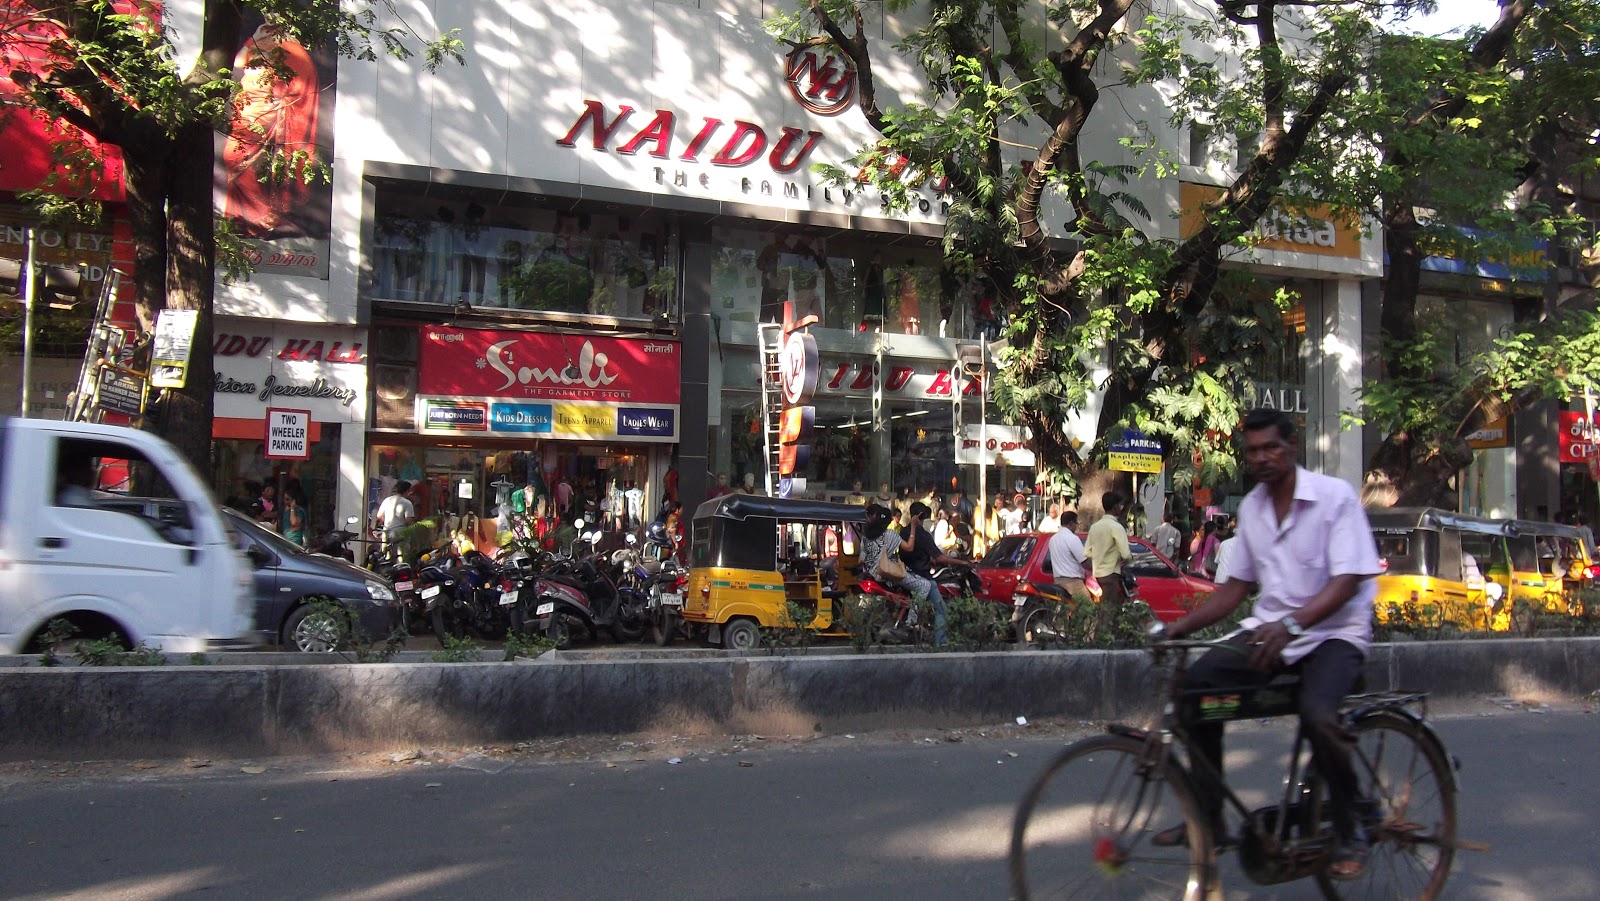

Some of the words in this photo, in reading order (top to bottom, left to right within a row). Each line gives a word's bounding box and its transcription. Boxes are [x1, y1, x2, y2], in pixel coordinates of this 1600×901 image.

[786, 52, 857, 99] NH
[556, 100, 827, 174] NAIDU
[653, 166, 709, 190] THE
[741, 177, 854, 206] FAMILY
[277, 339, 368, 363] HALL
[643, 342, 673, 353] सोनाली
[259, 374, 357, 406] Jewellery
[548, 389, 595, 398] GARMENT
[281, 414, 297, 426] TWO
[271, 427, 305, 439] WHEELER
[272, 439, 303, 451] PARKING
[1130, 439, 1161, 449] PARKING
